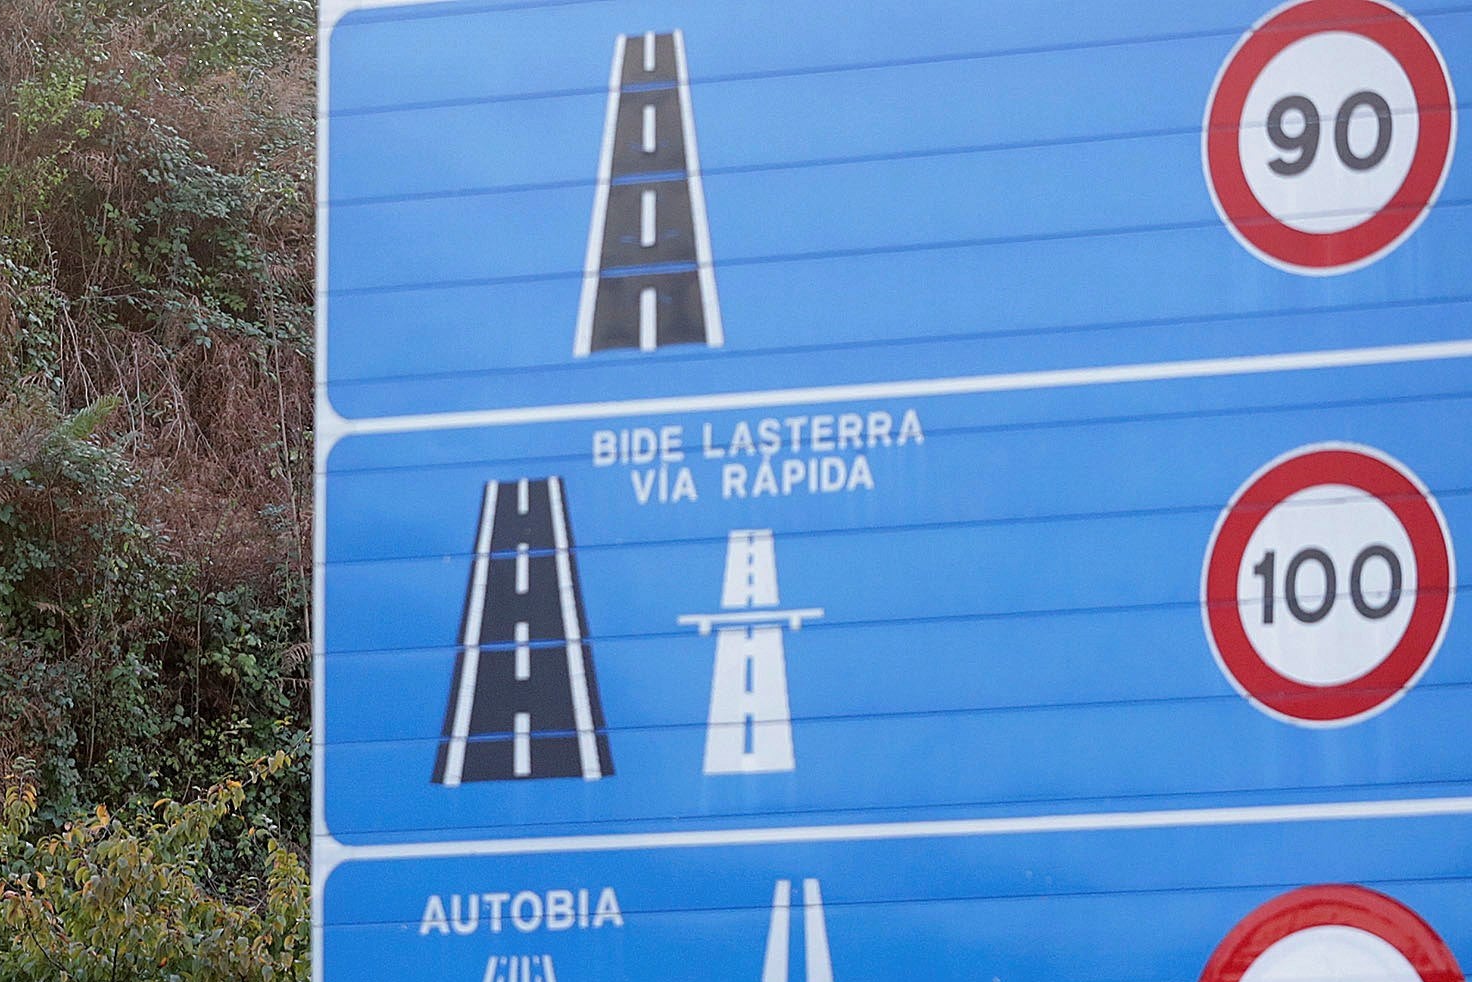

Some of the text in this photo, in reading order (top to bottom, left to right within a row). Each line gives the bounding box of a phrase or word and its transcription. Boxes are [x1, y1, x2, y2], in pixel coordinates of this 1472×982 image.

[1266, 90, 1393, 177] 90
[592, 408, 926, 467] BIDE LASTERRA
[1253, 544, 1403, 625] 100
[419, 886, 624, 935] AUTOBIA
